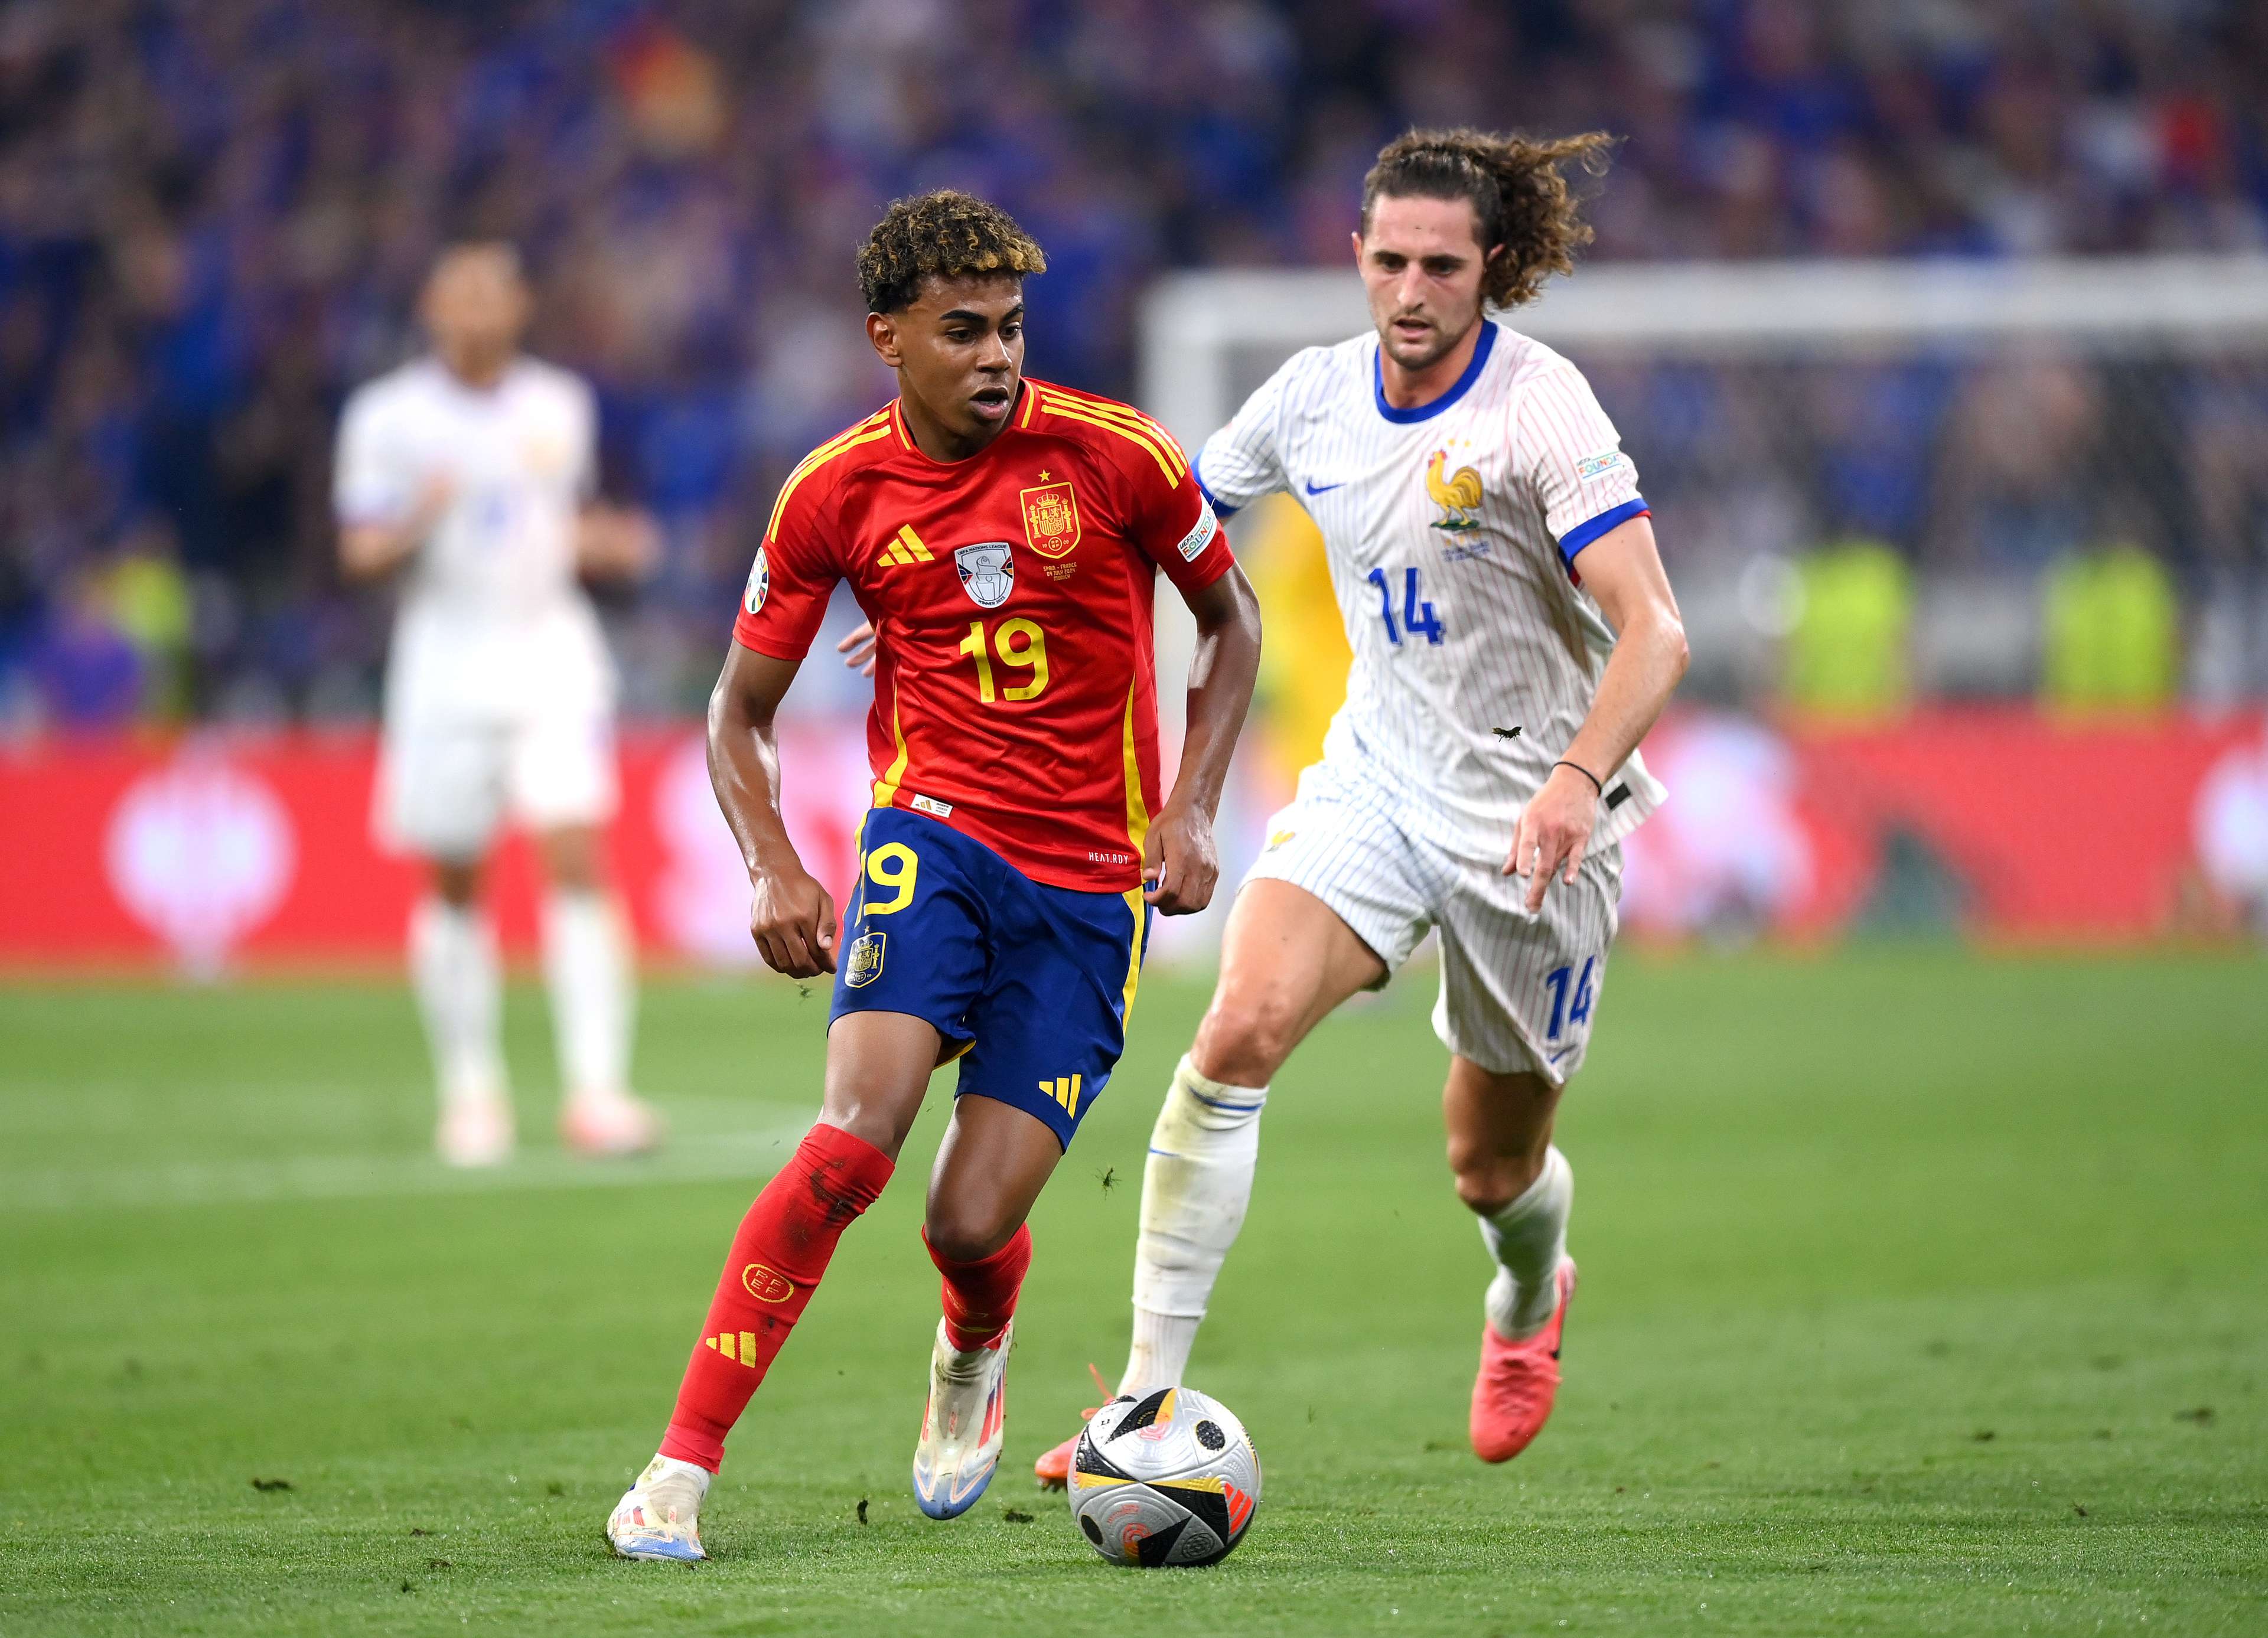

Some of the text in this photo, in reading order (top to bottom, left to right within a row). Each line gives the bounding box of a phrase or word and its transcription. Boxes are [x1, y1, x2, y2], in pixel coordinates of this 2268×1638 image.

[1179, 534, 1195, 550] UEFA
[1368, 567, 1445, 645] 14
[960, 618, 1049, 703] 19
[1089, 851, 1129, 864] HEAT.RDY
[1546, 955, 1595, 1039] 14
